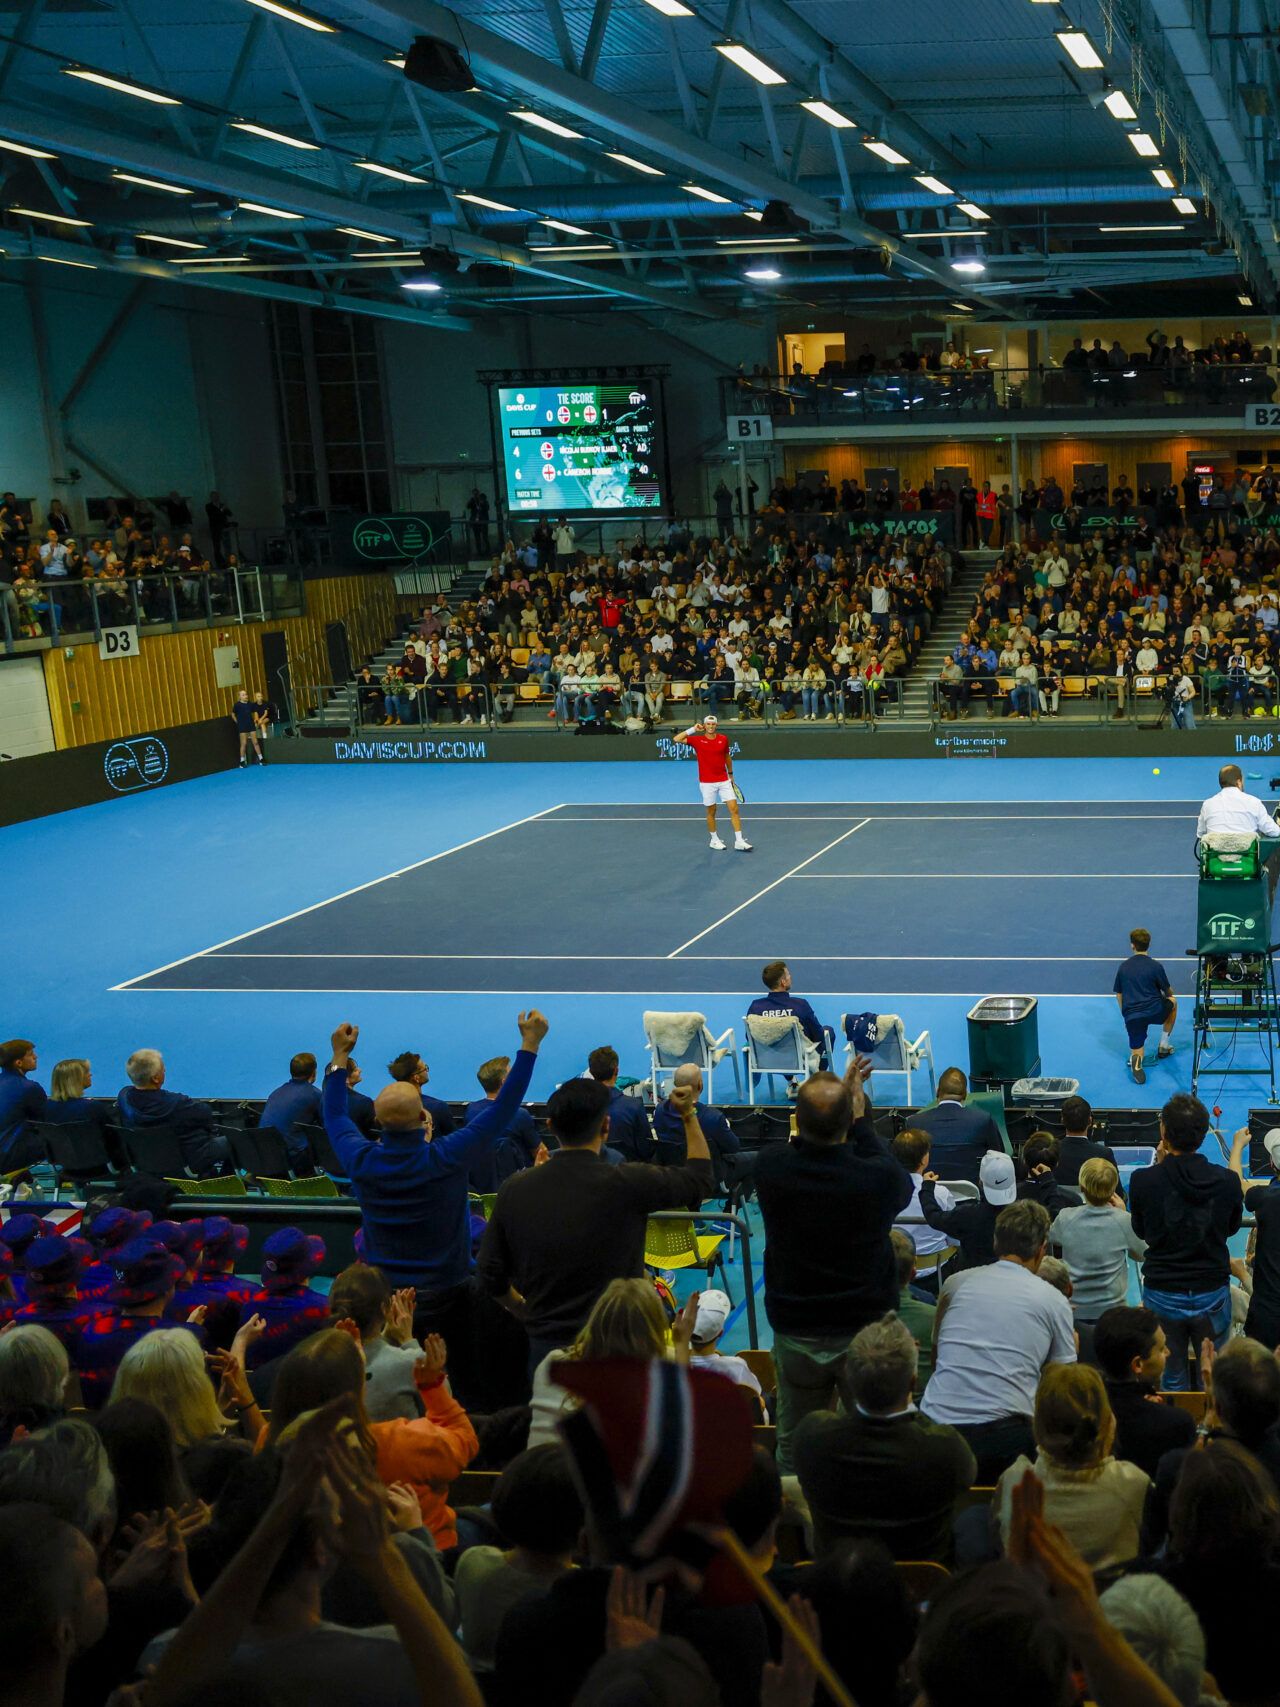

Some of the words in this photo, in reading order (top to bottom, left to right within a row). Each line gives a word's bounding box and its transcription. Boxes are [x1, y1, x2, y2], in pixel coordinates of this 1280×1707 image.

[558, 393, 570, 404] TIE
[570, 392, 595, 404] SCORE
[602, 408, 607, 420] 1
[738, 419, 762, 437] B1
[513, 446, 520, 457] 4
[622, 443, 628, 453] 2
[515, 468, 522, 480] 6
[638, 464, 648, 474] 40
[360, 535, 381, 547] ITF
[105, 631, 131, 653] D3
[334, 741, 486, 759] DAVISCUP.COM
[1211, 921, 1241, 936] ITF
[762, 1009, 793, 1017] GREAT
